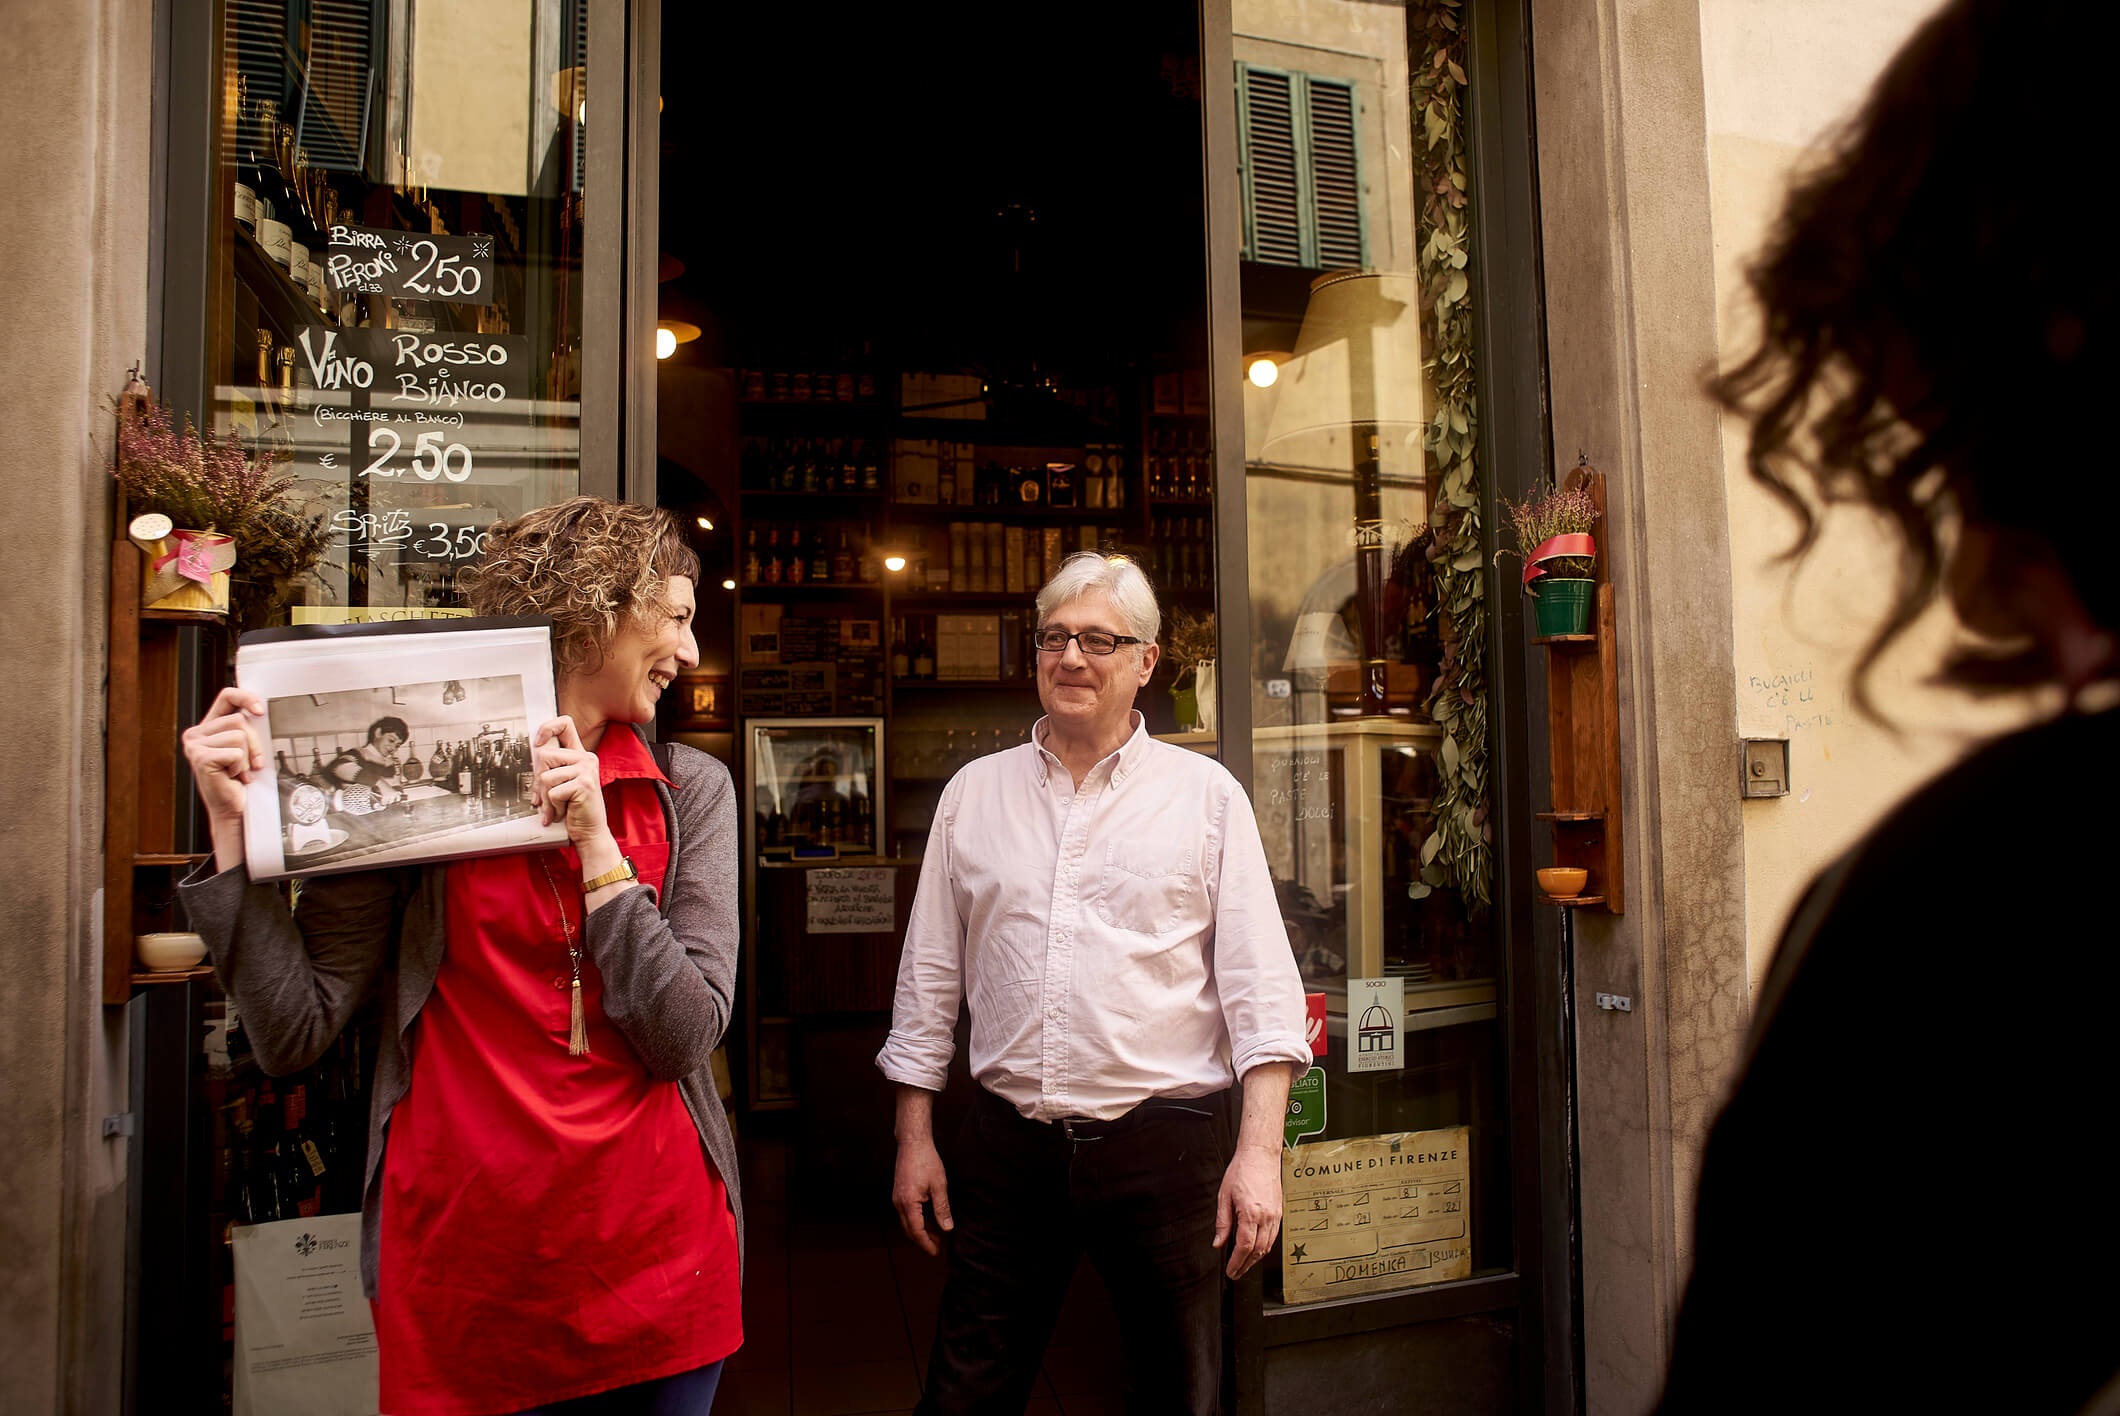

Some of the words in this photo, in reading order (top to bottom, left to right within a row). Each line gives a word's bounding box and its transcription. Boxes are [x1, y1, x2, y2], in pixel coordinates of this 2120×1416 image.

[402, 240, 482, 296] 2,50
[392, 334, 508, 368] ROSSO
[438, 368, 450, 378] e
[394, 413, 413, 424] AL
[319, 453, 338, 470] €
[1293, 1160, 1362, 1178] COMUNE
[1368, 1156, 1383, 1168] DI
[1390, 1150, 1457, 1166] FIRENZE
[1335, 1256, 1406, 1281] DOMENICA
